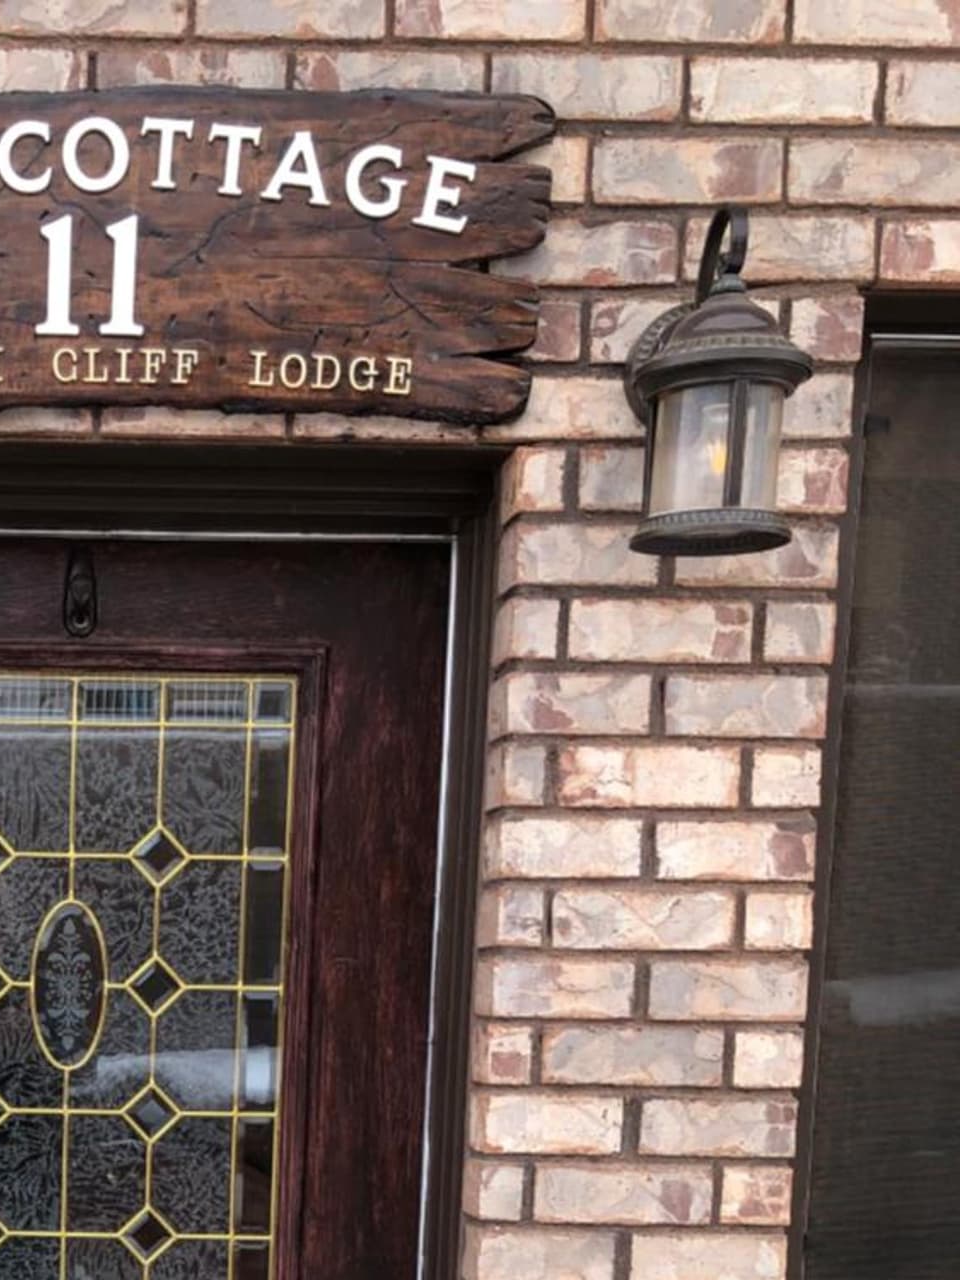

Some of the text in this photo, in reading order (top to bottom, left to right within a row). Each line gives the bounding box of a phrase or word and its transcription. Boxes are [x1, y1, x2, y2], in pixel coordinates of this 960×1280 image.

[34, 213, 145, 337] 11
[52, 347, 199, 385] CLIFF
[247, 350, 413, 395] LODGE
